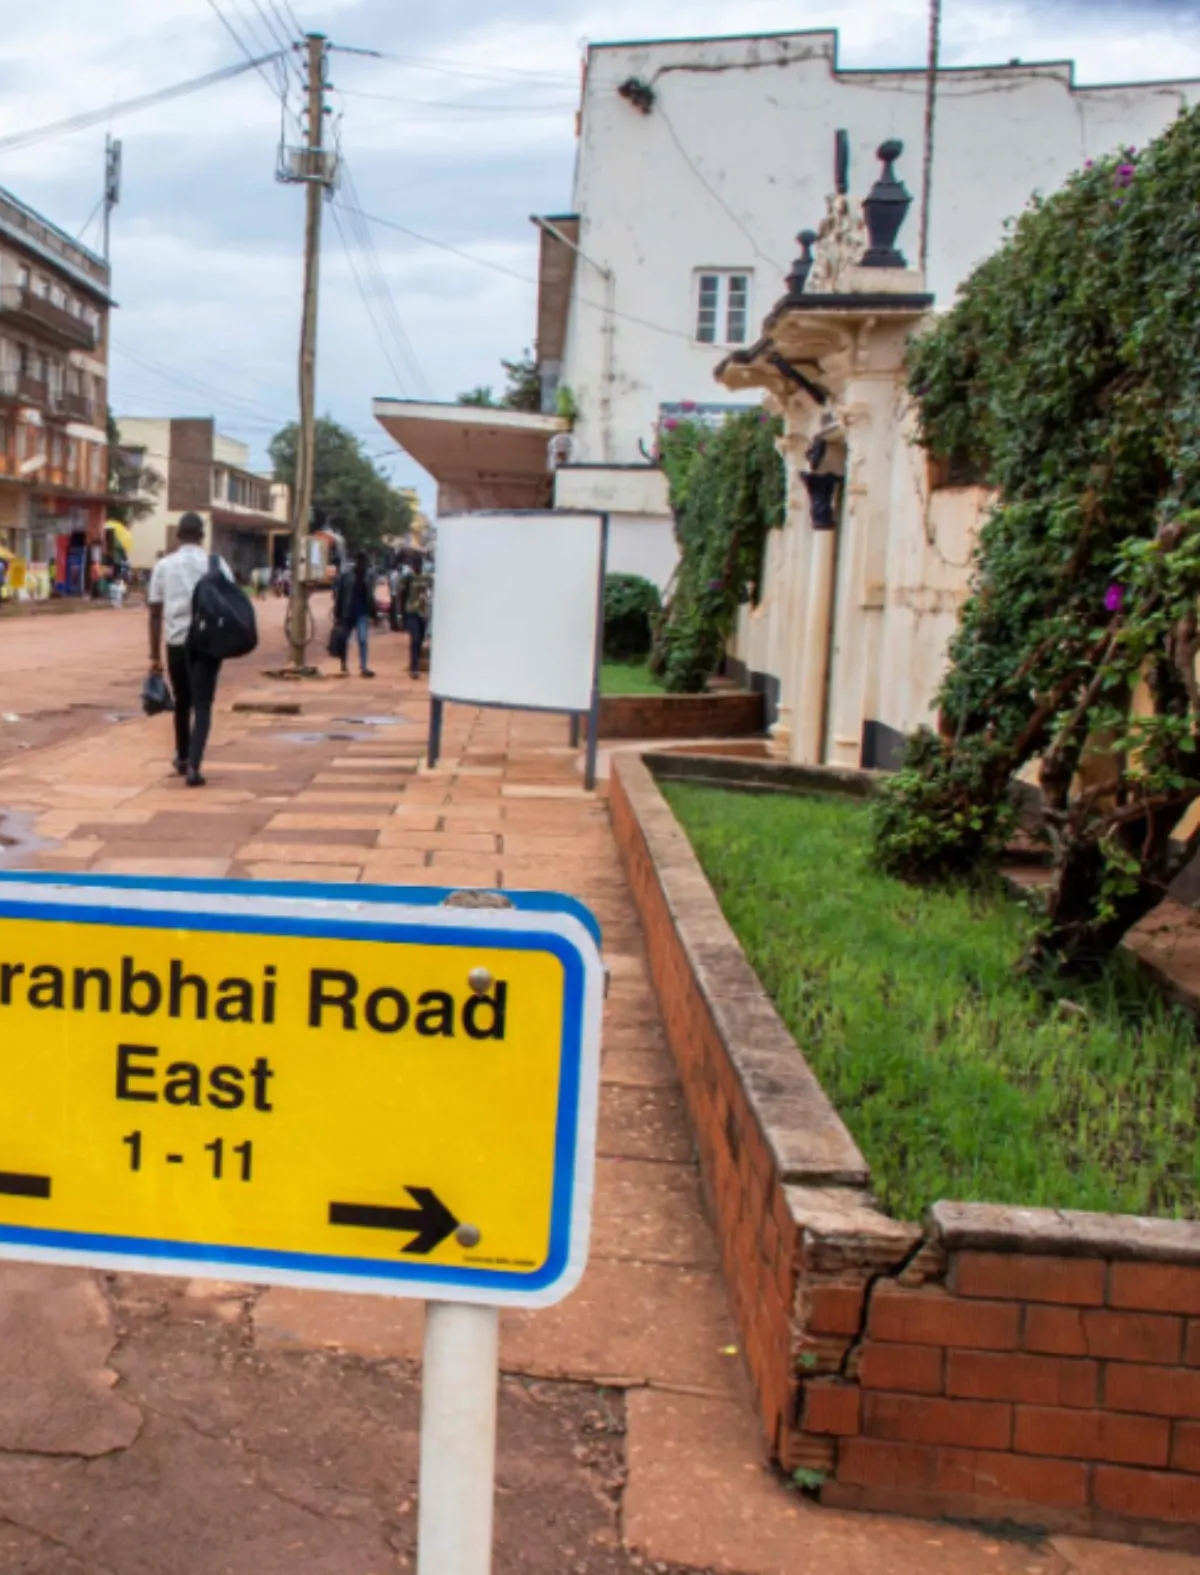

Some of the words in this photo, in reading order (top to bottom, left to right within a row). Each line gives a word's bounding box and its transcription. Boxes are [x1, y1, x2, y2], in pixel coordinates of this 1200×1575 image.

[308, 968, 508, 1041] Road
[115, 1043, 274, 1113] East
[122, 1130, 142, 1171] 1
[206, 1137, 253, 1182] 11
